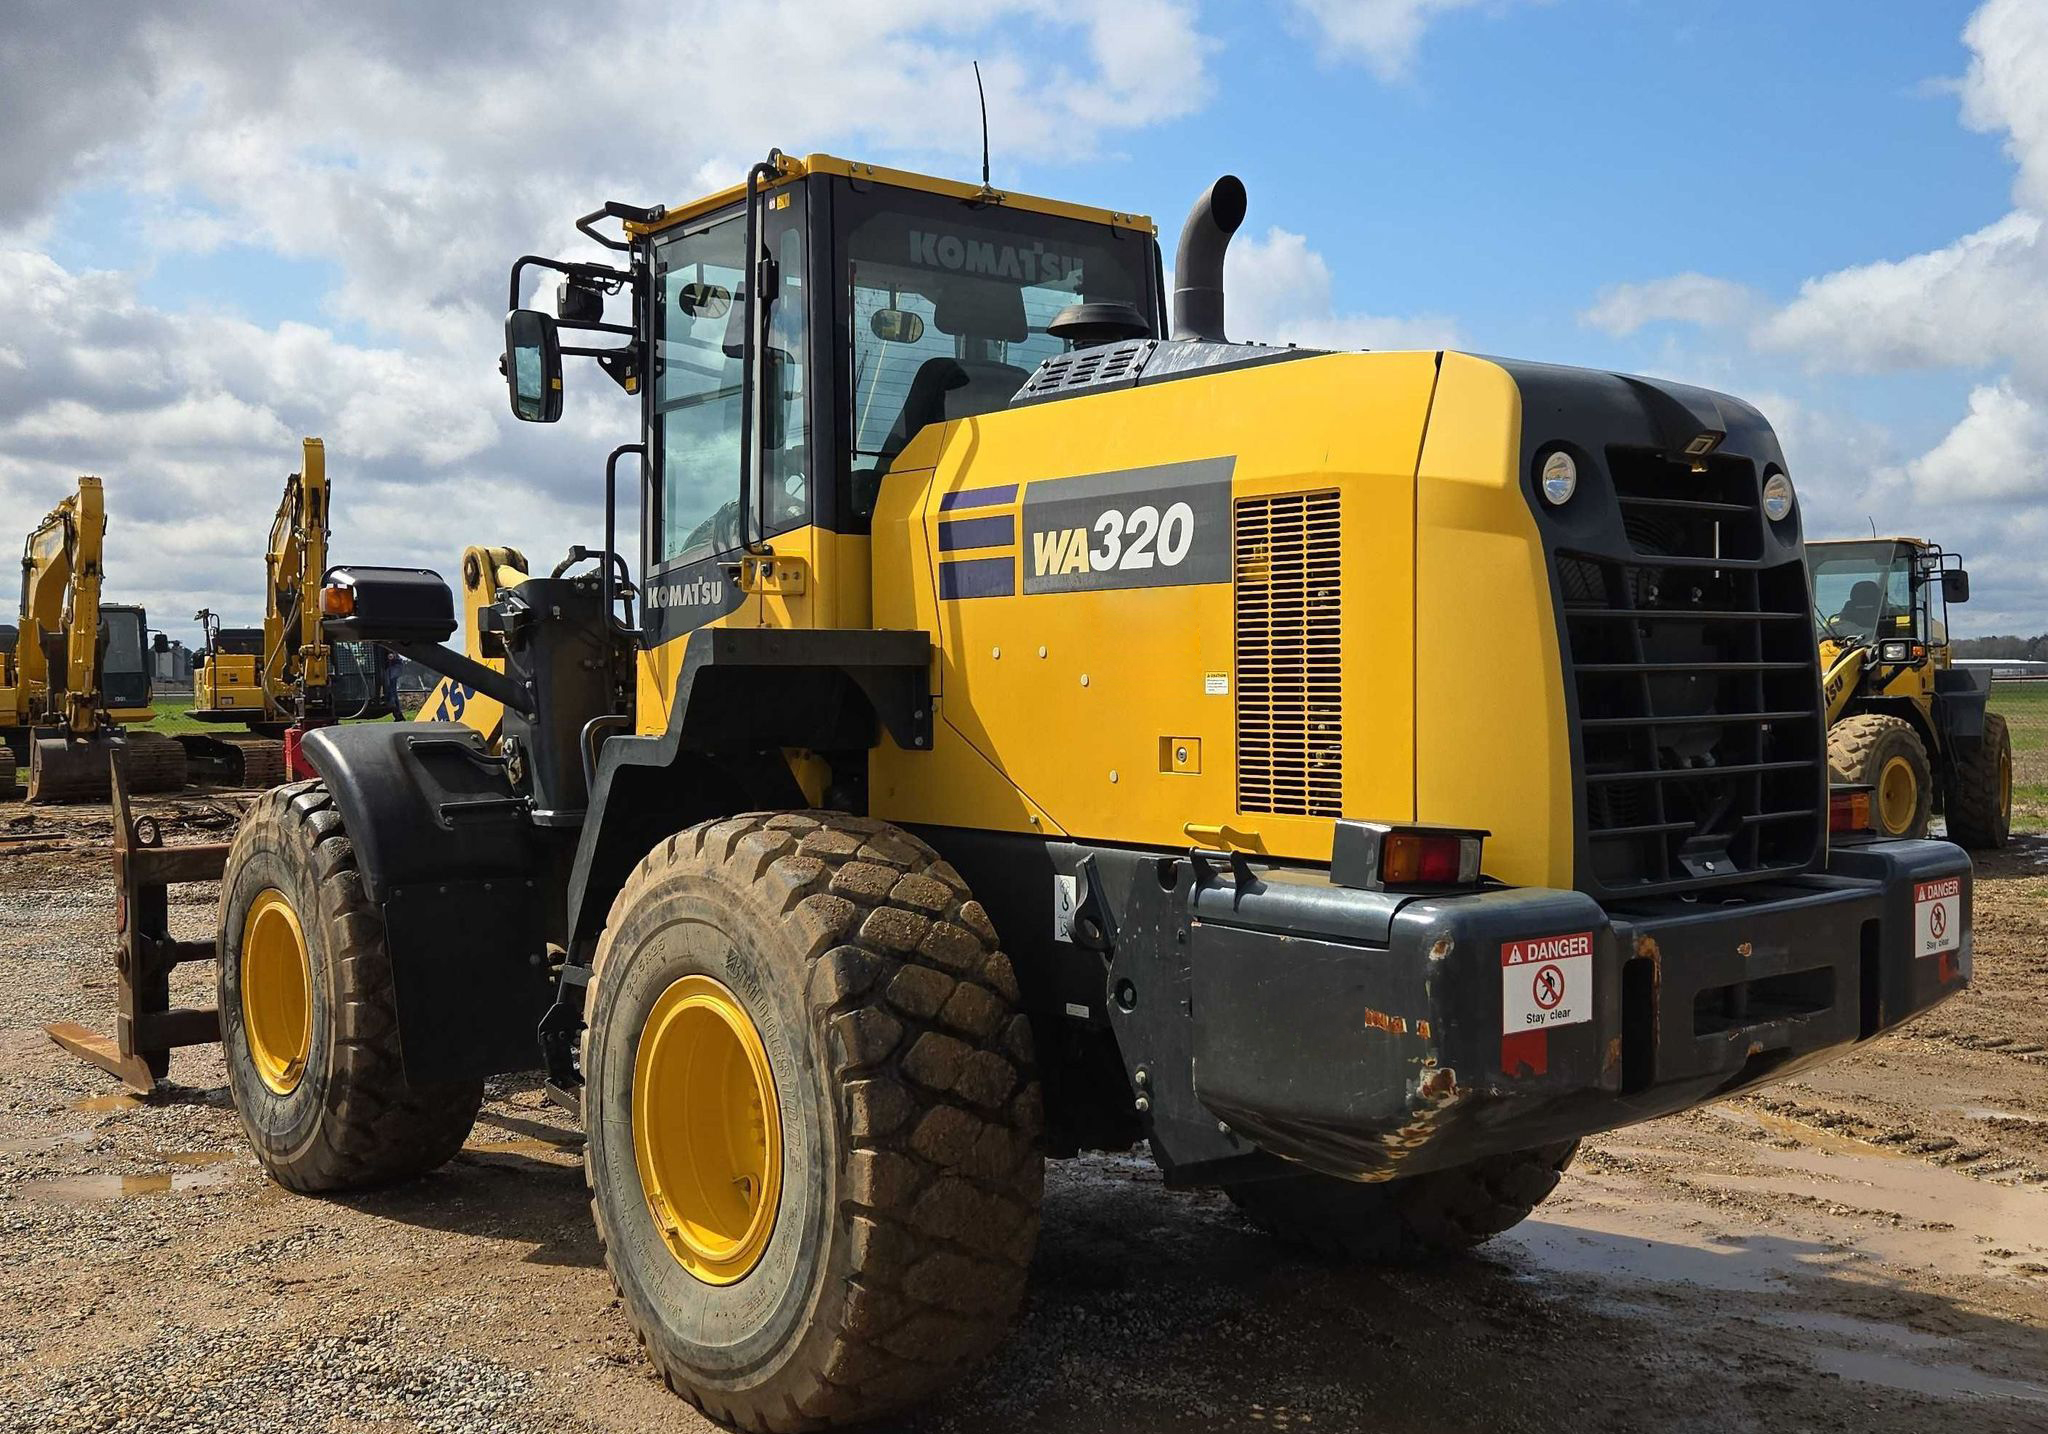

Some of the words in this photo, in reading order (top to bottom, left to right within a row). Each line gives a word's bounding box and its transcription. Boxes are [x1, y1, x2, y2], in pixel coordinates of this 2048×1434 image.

[909, 230, 1084, 285] KOMATSU
[1033, 502, 1195, 576] WA320
[647, 576, 722, 609] KOMATSU
[1927, 881, 1959, 900] DANGER
[1527, 937, 1589, 961] DANGER
[1526, 1012, 1546, 1025] Stay
[1550, 1008, 1571, 1020] clear
